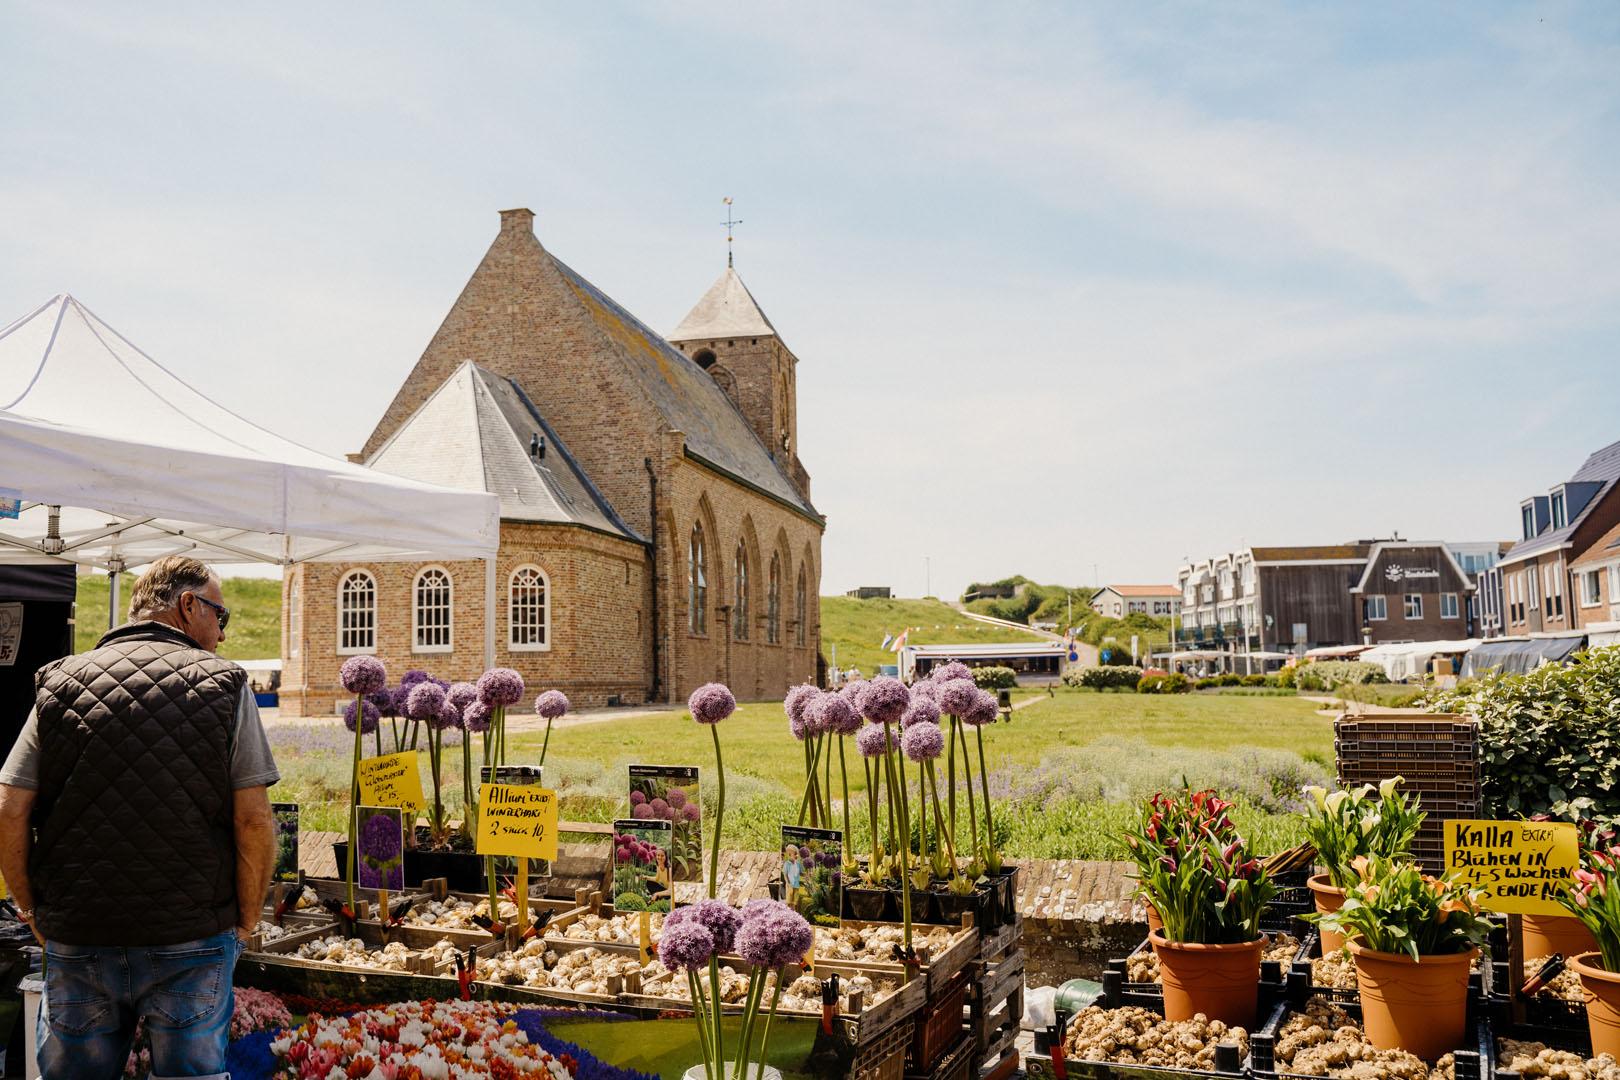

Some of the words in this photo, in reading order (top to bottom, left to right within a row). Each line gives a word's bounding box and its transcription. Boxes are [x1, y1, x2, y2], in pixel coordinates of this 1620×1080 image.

[489, 786, 526, 804] Allium
[489, 820, 500, 836] 2
[1468, 868, 1501, 882] 4-5
[1497, 883, 1540, 897] ENDE
